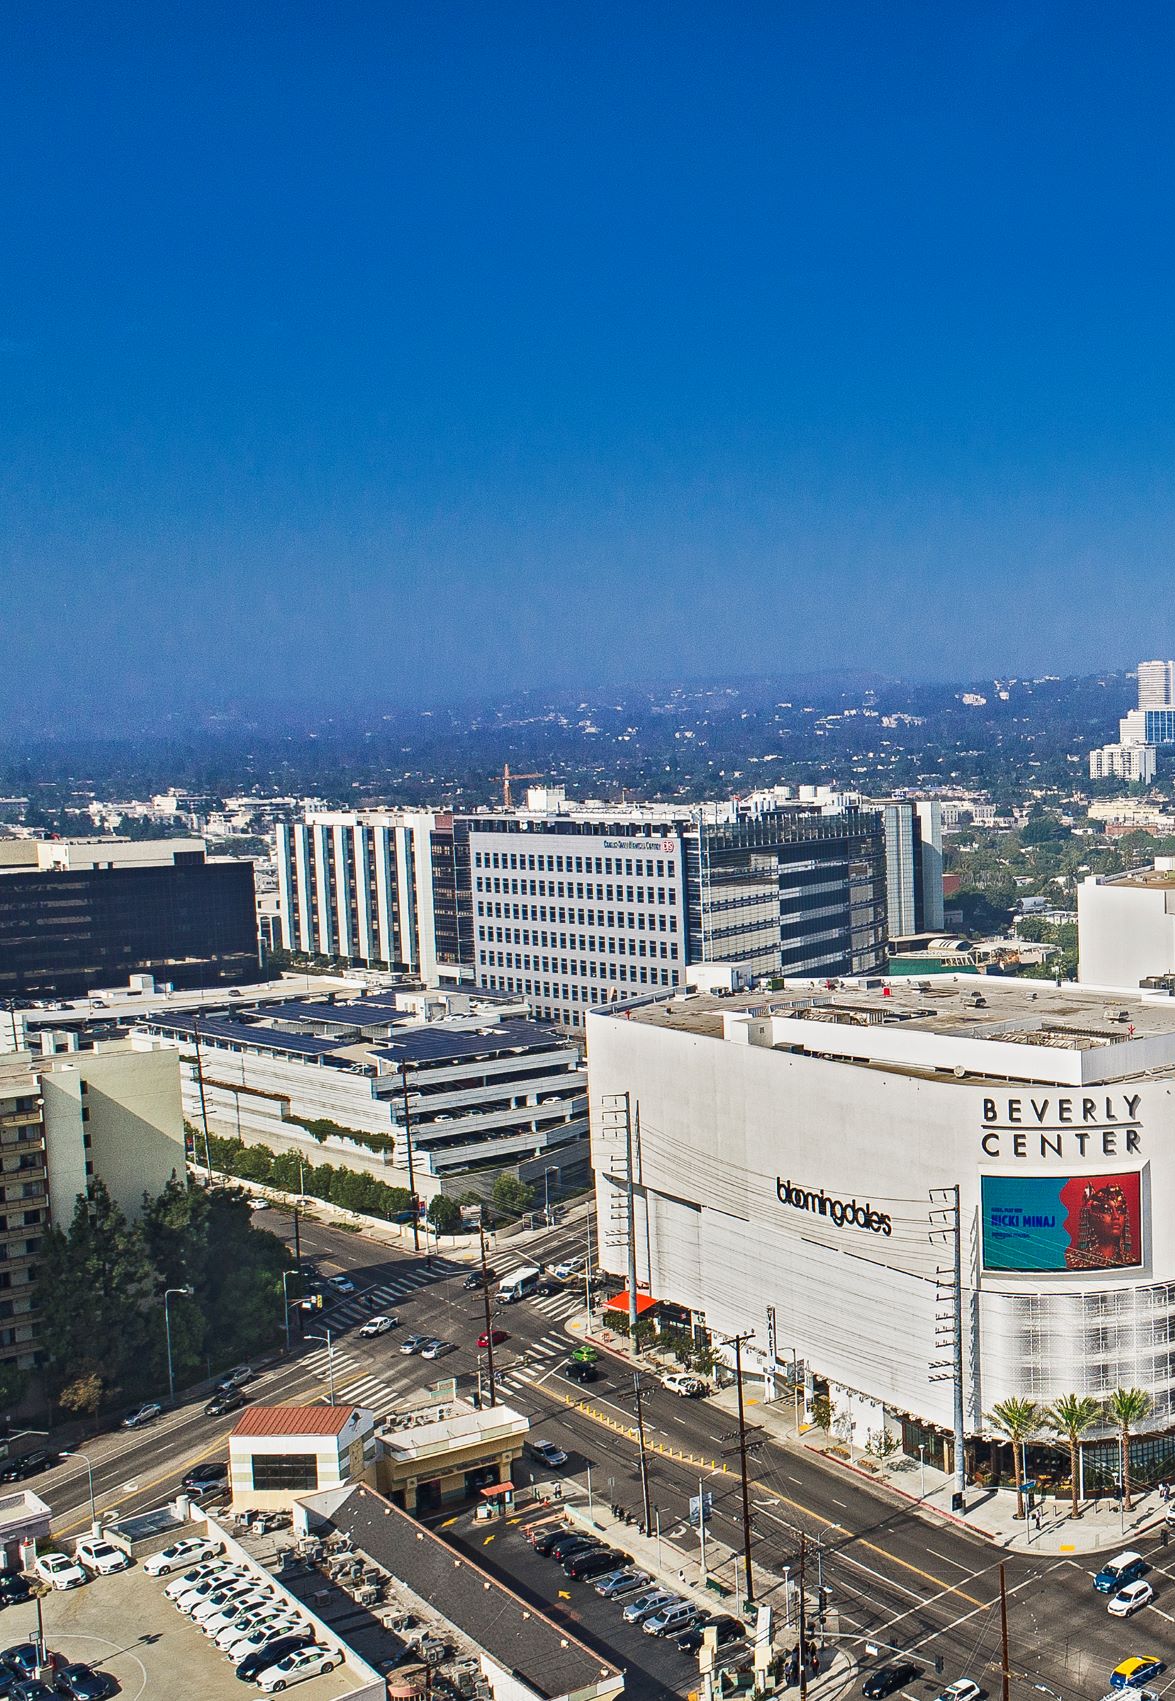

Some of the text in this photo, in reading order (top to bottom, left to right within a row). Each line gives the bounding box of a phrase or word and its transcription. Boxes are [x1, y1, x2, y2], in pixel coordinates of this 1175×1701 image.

[983, 1094, 1142, 1124] BEVERLY
[981, 1130, 1142, 1158] CENTER
[776, 1176, 892, 1236] bloomingdale's
[991, 1215, 1056, 1228] NICKI MINAJ
